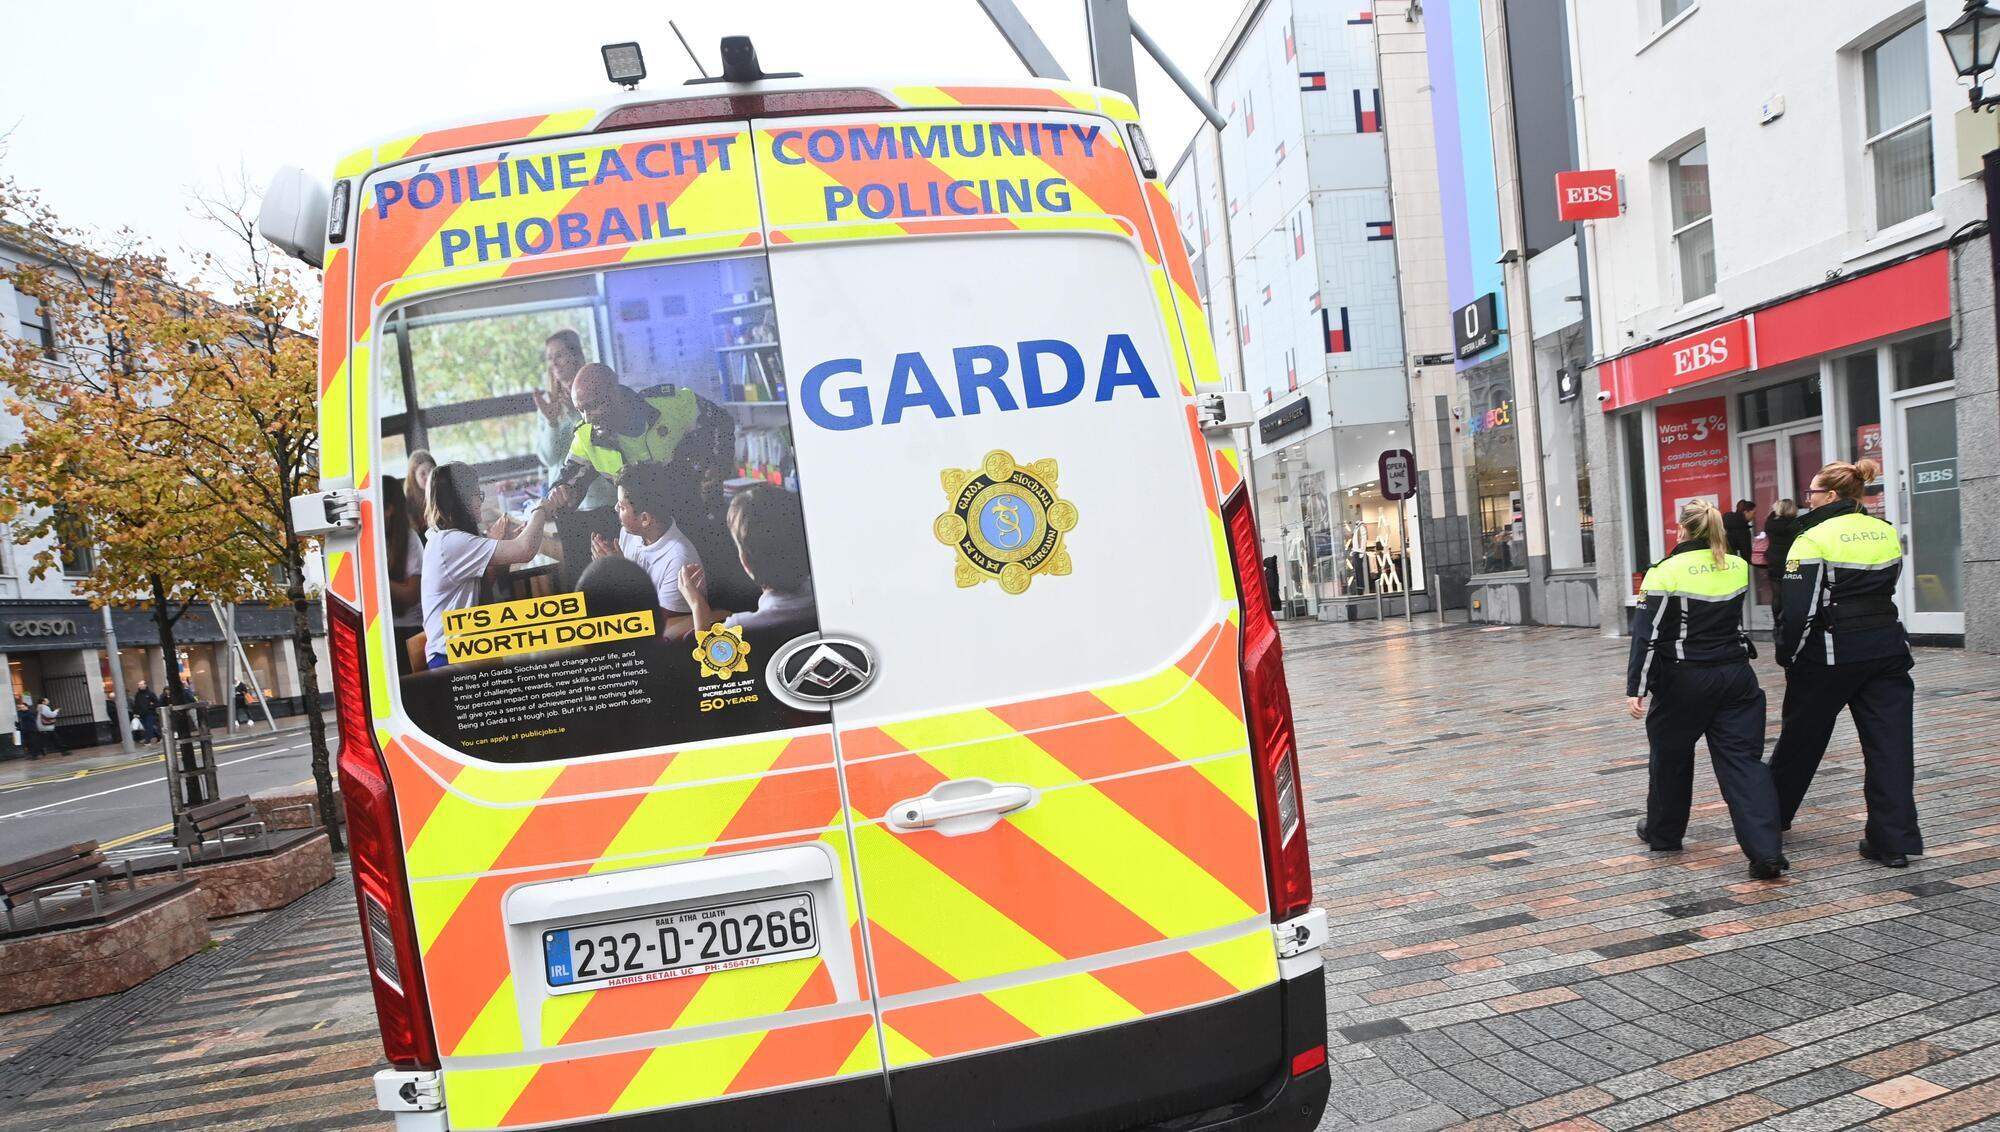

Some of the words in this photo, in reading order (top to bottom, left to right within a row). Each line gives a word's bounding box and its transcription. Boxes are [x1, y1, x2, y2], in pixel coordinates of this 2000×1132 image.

[771, 122, 1101, 165] COMMUNITY
[373, 136, 737, 219] PÓILÍNEACHT
[823, 177, 1072, 221] POLICING
[1565, 185, 1613, 204] EBS
[439, 201, 687, 267] PHOBAIL
[1672, 335, 1728, 376] EBS
[800, 333, 1160, 431] GARDA
[1659, 422, 1688, 434] Want
[1661, 435, 1676, 444] up
[1677, 432, 1688, 441] to
[1691, 415, 1726, 441] 3%
[1387, 462, 1407, 471] OPERA
[1662, 463, 1680, 472] your
[1682, 456, 1728, 469] mortgage?
[1667, 449, 1708, 461] cashback
[1710, 448, 1721, 456] on
[1917, 468, 1953, 484] EBS
[958, 481, 984, 510] GARDA
[1840, 531, 1888, 543] GARDA
[972, 552, 985, 567] NA
[446, 609, 491, 631] IT'S
[500, 607, 518, 624] A
[525, 597, 579, 620] JOB
[9, 619, 77, 636] eason
[450, 629, 547, 658] WORTH
[556, 616, 649, 643] DOING.
[451, 673, 477, 683] Joining
[491, 668, 512, 676] Garda
[562, 657, 588, 666] change
[590, 655, 605, 663] your
[622, 650, 636, 658] and
[491, 678, 515, 686] others.
[551, 668, 582, 677] moment
[598, 664, 614, 672] join,
[455, 703, 470, 711] Your
[472, 698, 502, 710] personal
[503, 695, 528, 704] impact
[542, 689, 567, 699] people
[568, 687, 582, 695] and
[597, 680, 639, 690] community
[483, 686, 523, 697] challenges,
[524, 681, 554, 691] rewards,
[572, 676, 589, 684] skills
[591, 673, 605, 681] and
[622, 668, 650, 677] friends.
[702, 688, 742, 698] INCREASED
[458, 722, 479, 730] Being
[486, 717, 508, 726] Garda
[524, 712, 545, 720] tough
[546, 710, 560, 718] job.
[595, 703, 607, 711] job
[608, 700, 628, 708] worth
[630, 697, 653, 705] doing.
[469, 712, 483, 720] give
[538, 697, 583, 708] achievement
[599, 690, 627, 699] nothing
[700, 698, 725, 712] 50
[725, 694, 759, 705] YEARS
[490, 734, 509, 743] apply
[520, 727, 566, 739] publicjobs.ie
[655, 916, 674, 927] BAILE
[679, 912, 697, 923] ÁTHA
[701, 910, 726, 920] CLIATH
[575, 907, 812, 977] 232-D-20266
[551, 965, 569, 978] IRL
[608, 973, 643, 986] HARRIS
[645, 970, 678, 982] RETAIL
[680, 967, 694, 977] UC
[705, 963, 720, 972] PH:
[722, 958, 760, 970] 4564747
